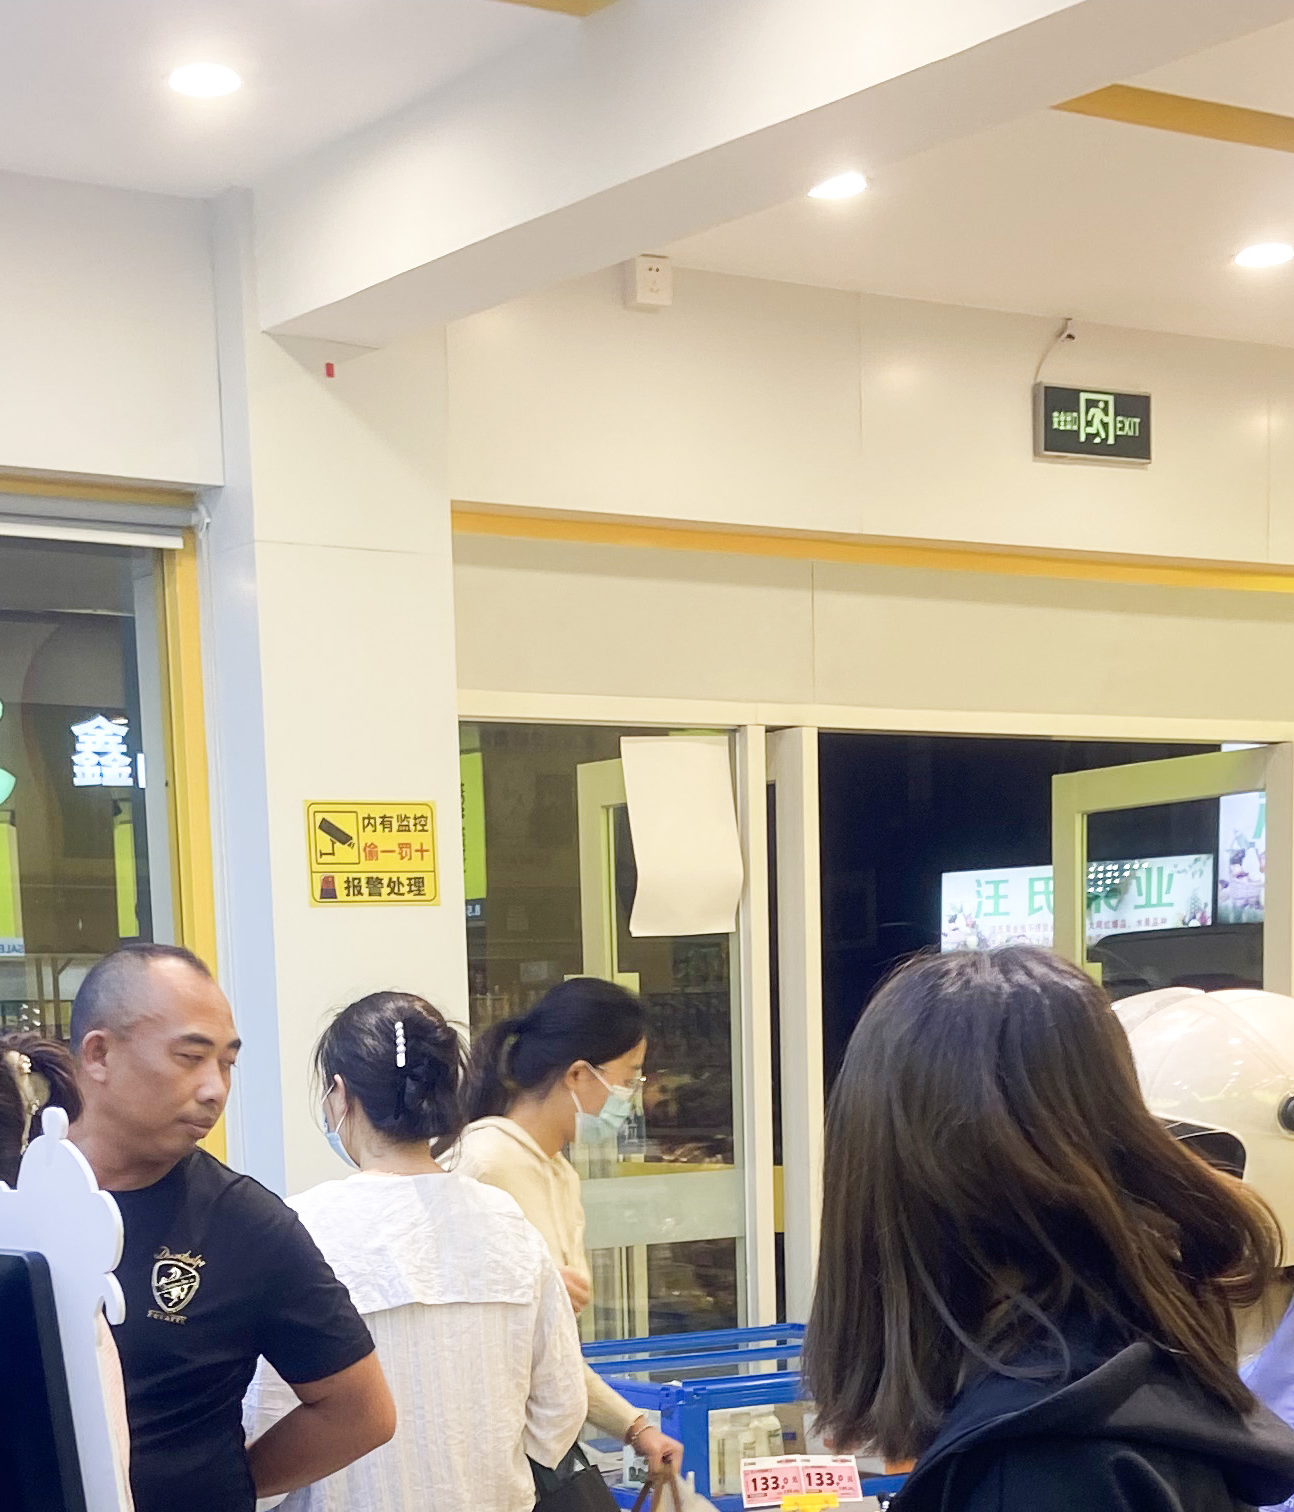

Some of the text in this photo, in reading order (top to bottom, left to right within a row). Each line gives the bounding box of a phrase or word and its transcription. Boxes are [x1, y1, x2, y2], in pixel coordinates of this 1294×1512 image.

[1115, 416, 1141, 436] EXIT
[70, 714, 147, 789] 鑫
[362, 813, 429, 833] 内有监控
[363, 842, 430, 862] 偷一罚十
[344, 876, 427, 897] 报警处理
